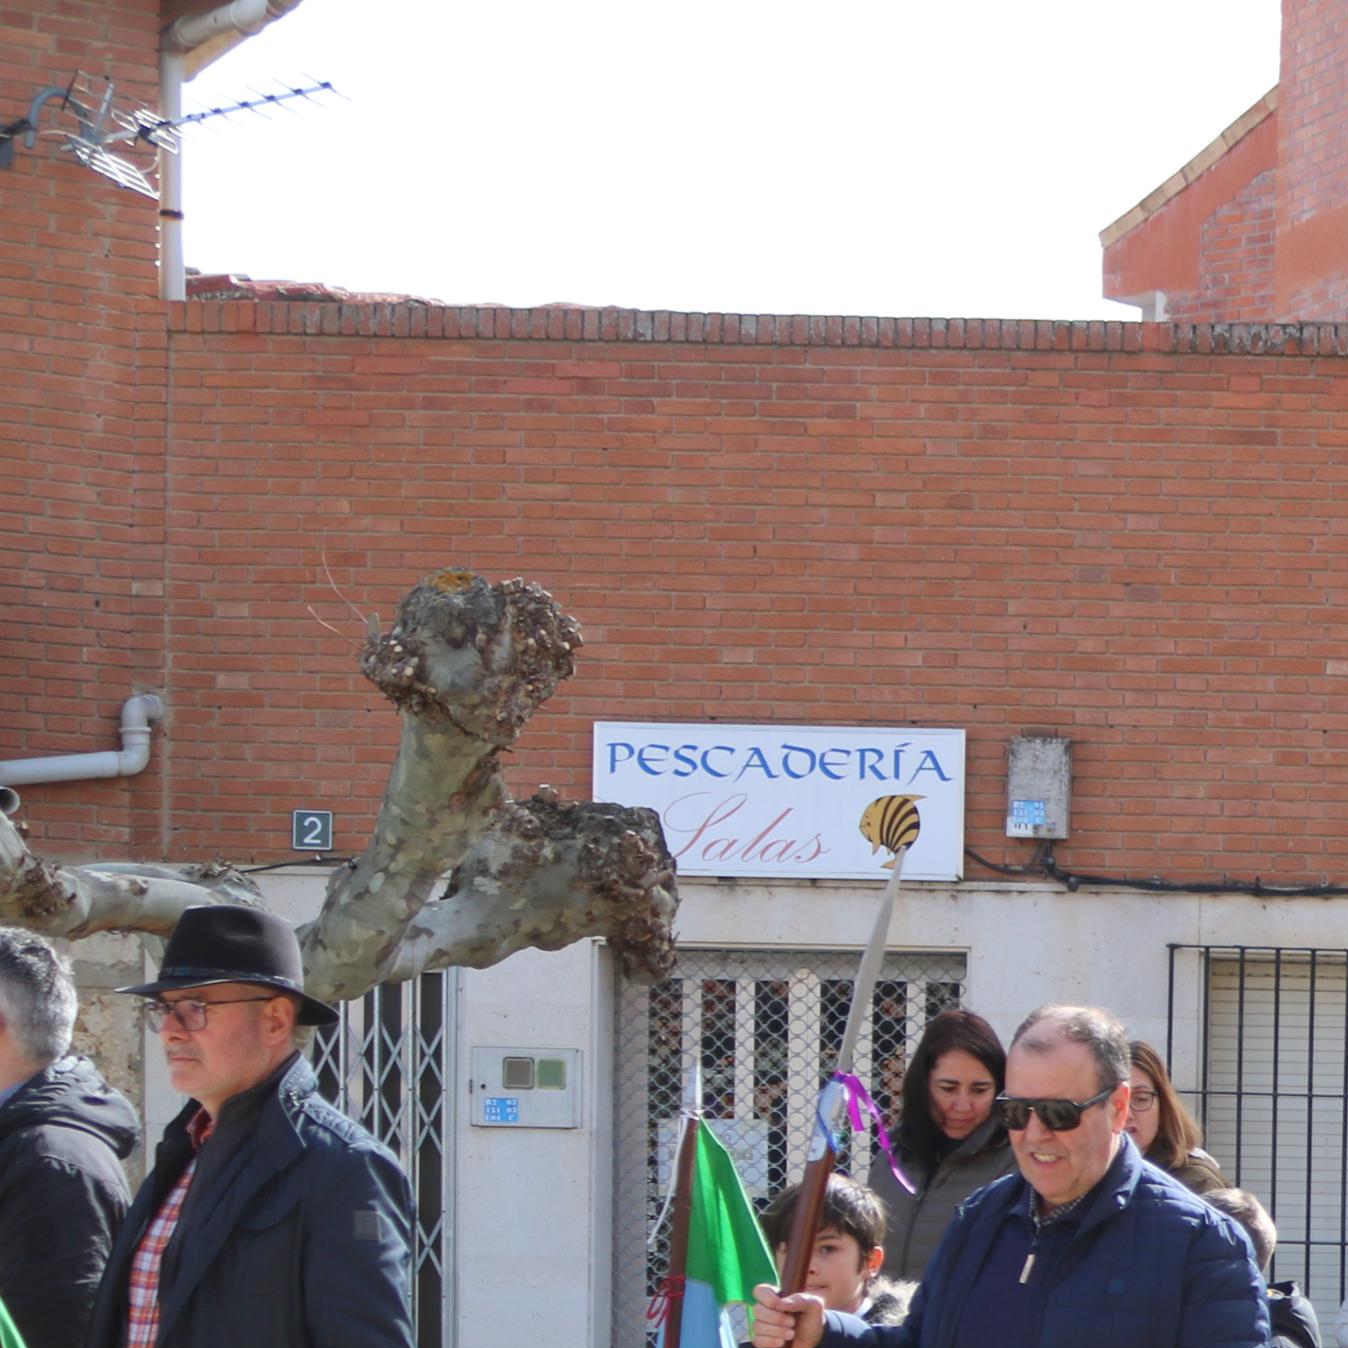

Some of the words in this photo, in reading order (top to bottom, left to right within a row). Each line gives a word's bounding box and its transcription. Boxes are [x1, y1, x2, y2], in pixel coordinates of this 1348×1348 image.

[606, 741, 954, 786] PESCADERÍA
[303, 816, 322, 844] 2
[663, 792, 831, 864] Salas
